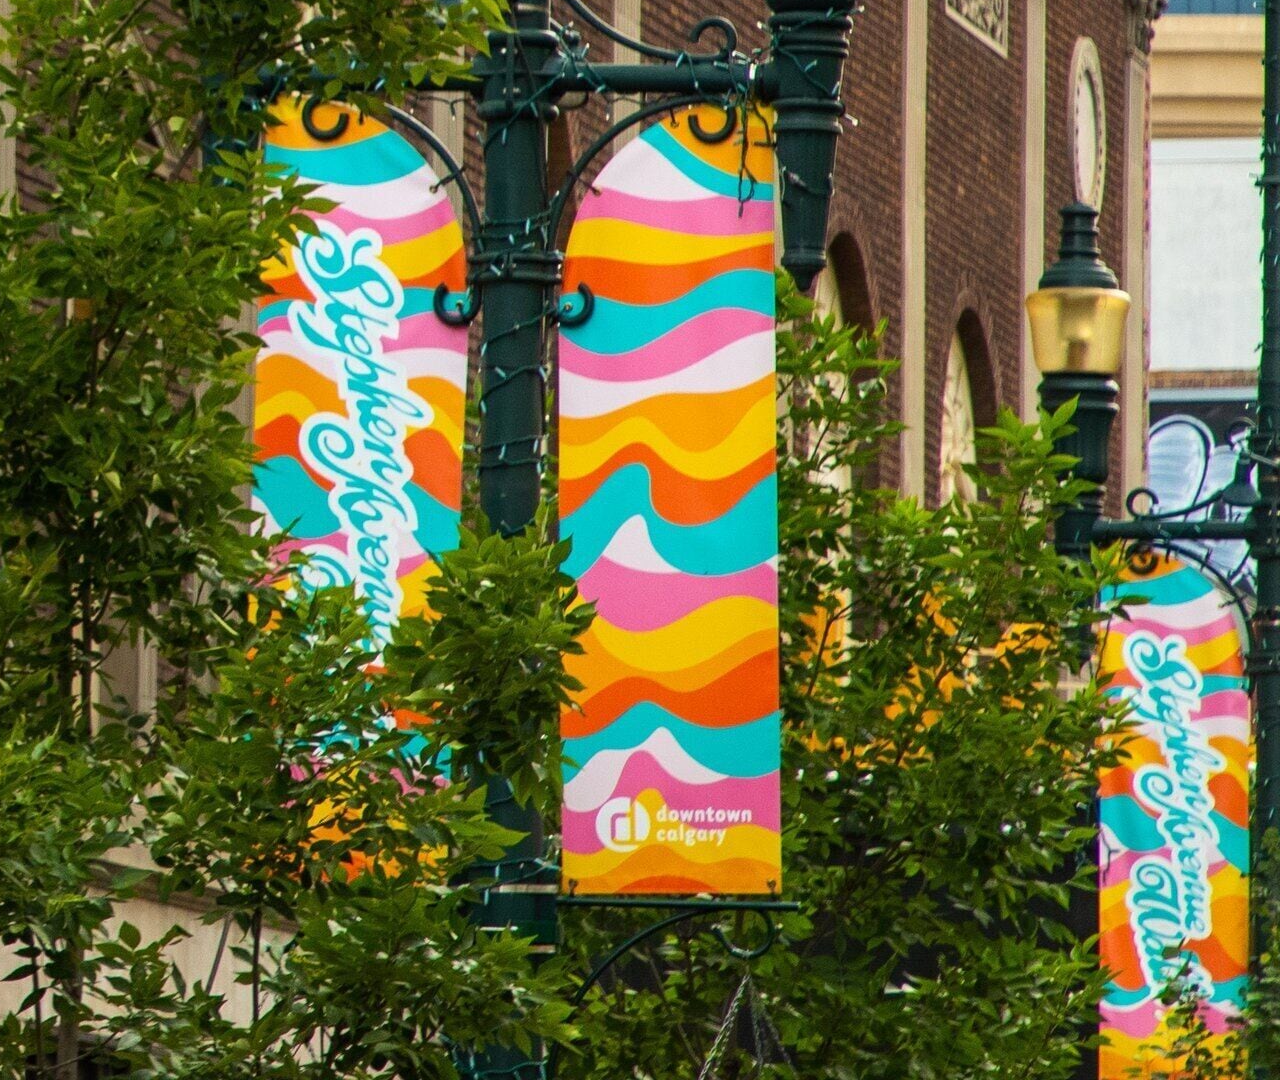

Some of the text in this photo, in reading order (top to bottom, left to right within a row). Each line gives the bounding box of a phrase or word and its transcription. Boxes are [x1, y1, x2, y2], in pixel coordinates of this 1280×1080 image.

[296, 233, 425, 482] Stephen
[656, 804, 752, 823] downtown
[656, 824, 726, 848] calgary
